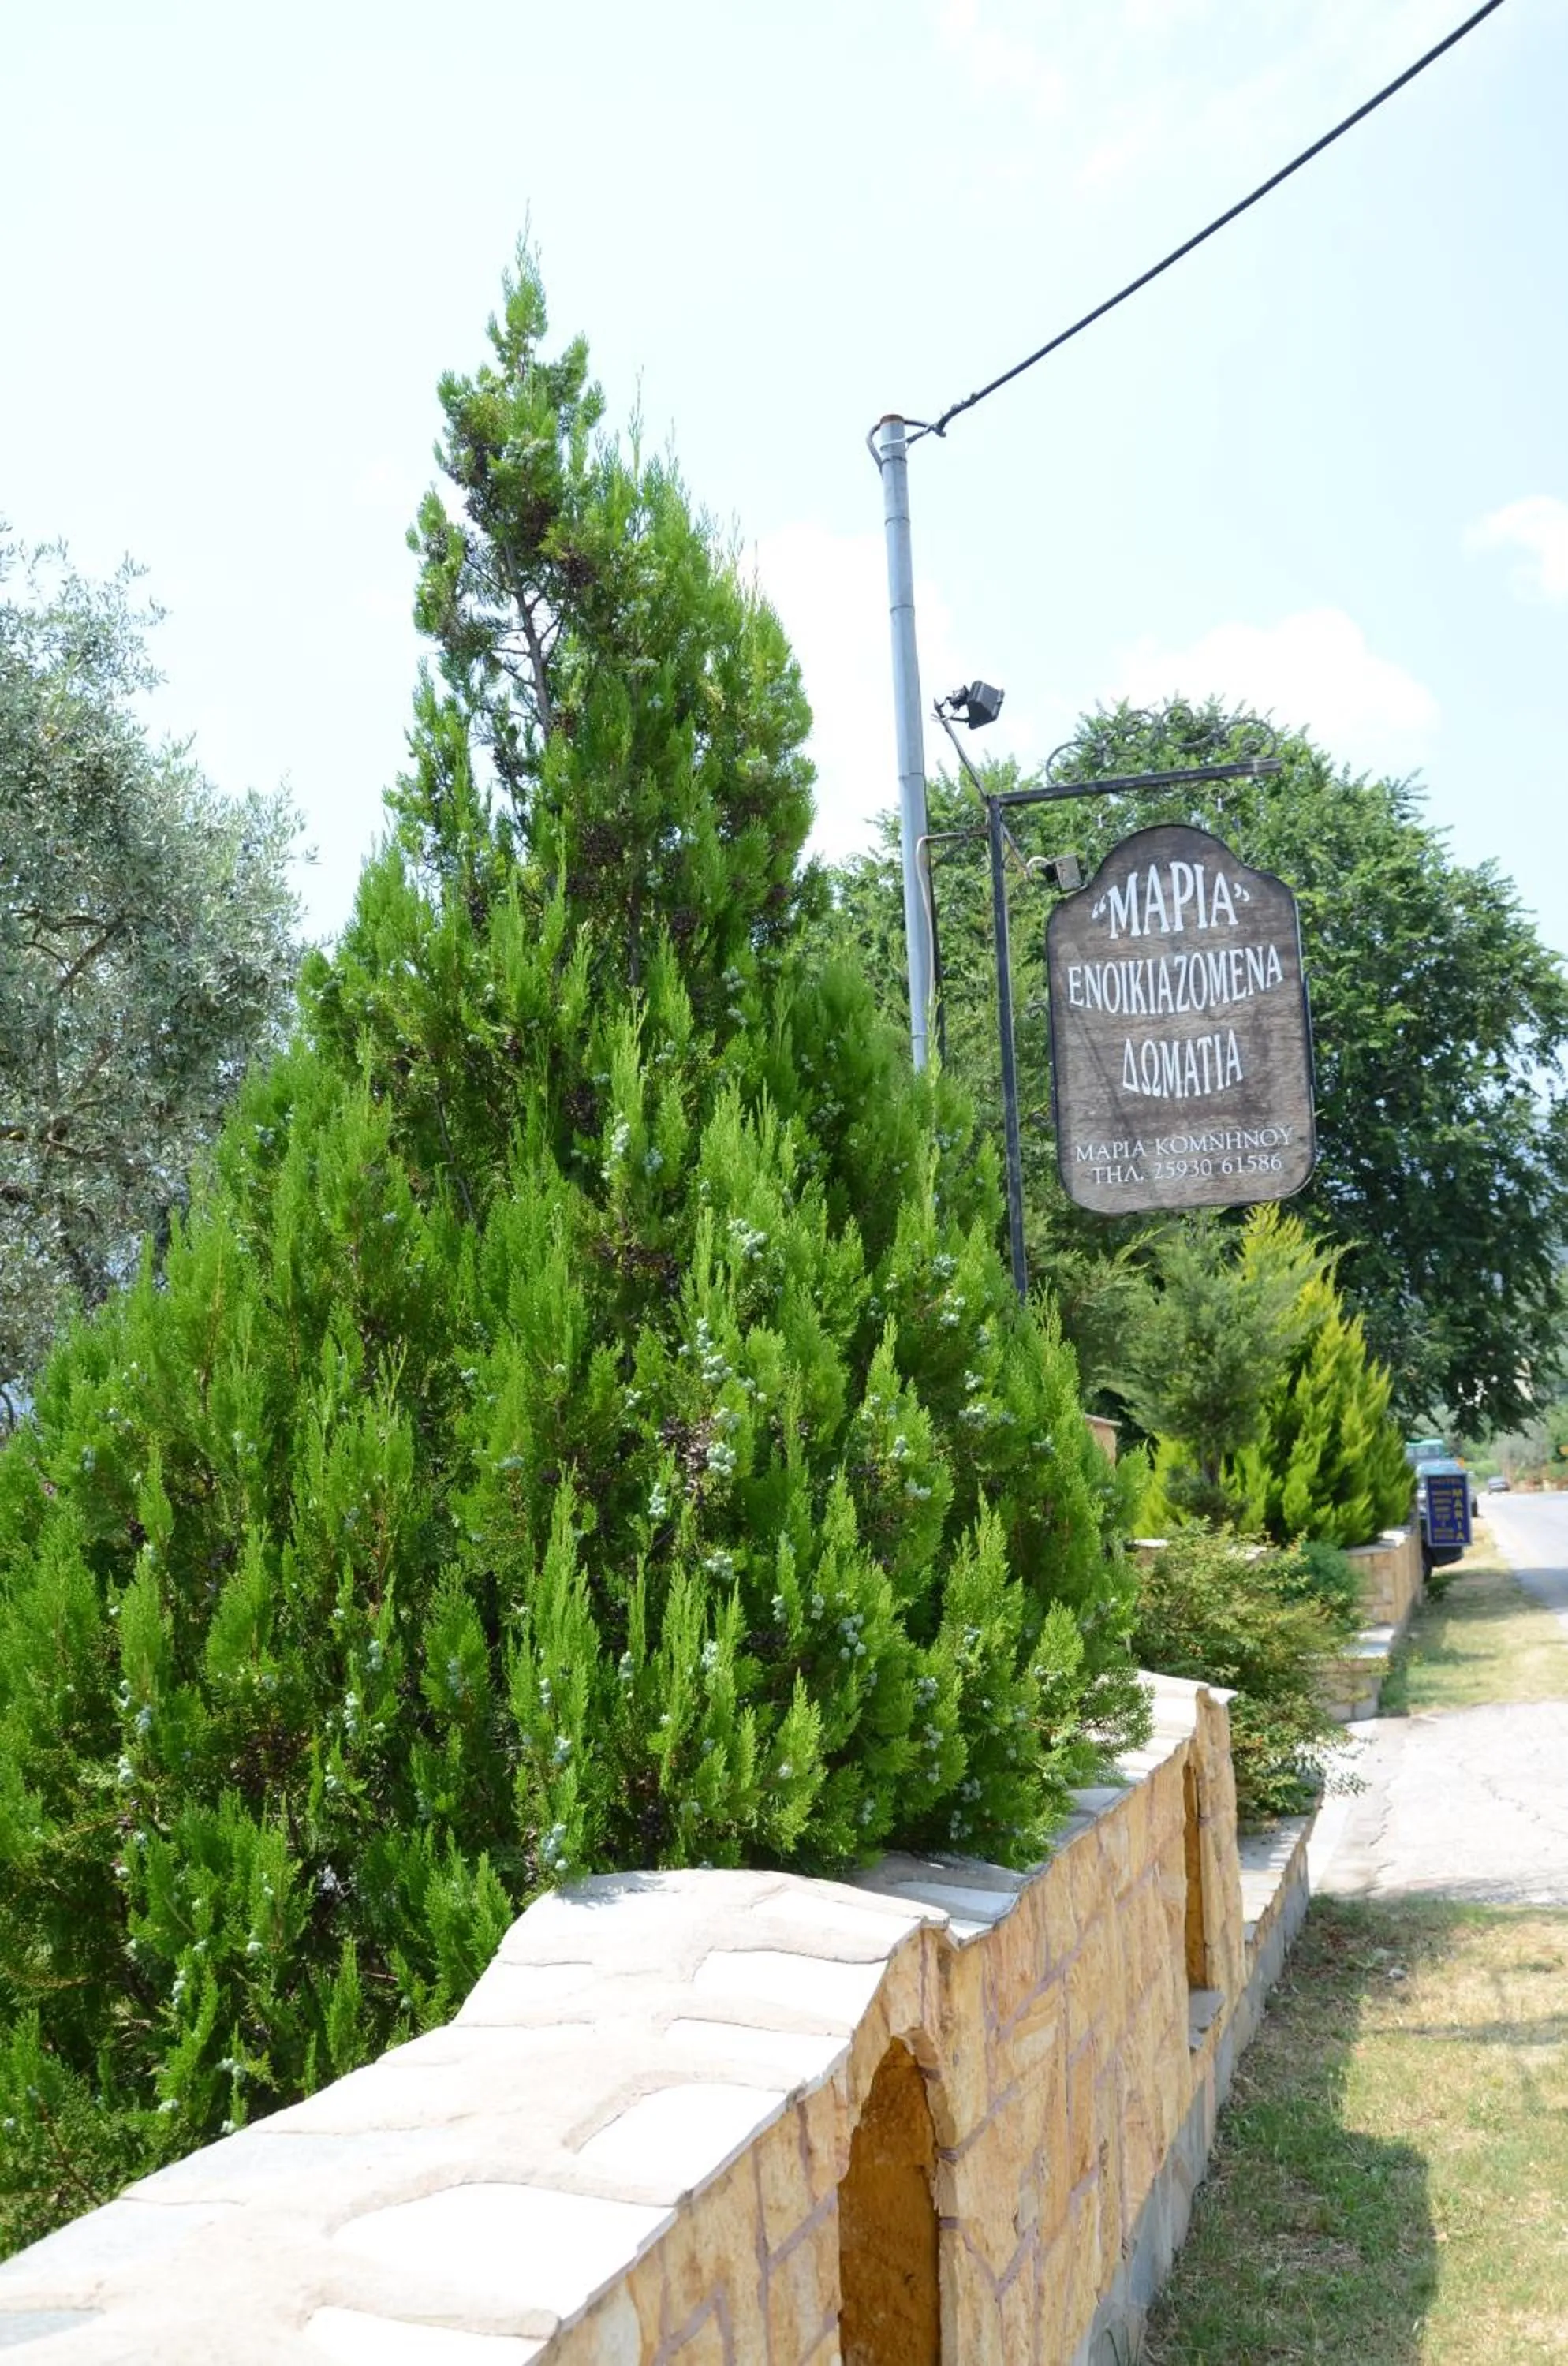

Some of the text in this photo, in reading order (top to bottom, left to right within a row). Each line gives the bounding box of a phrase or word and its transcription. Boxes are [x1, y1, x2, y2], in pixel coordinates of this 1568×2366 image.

[1068, 944, 1283, 1014] ΕΝΟΙΚΙΑΖΟΜΕΝΑ
[1122, 1028, 1243, 1098] ΔΩΜΑΤΙΑ
[1076, 1127, 1294, 1162] ΜΑΡΙΑ ΚΟΜΝΗΝΟΥ
[1092, 1153, 1282, 1185] ΤΗΛ. 25930 61586
